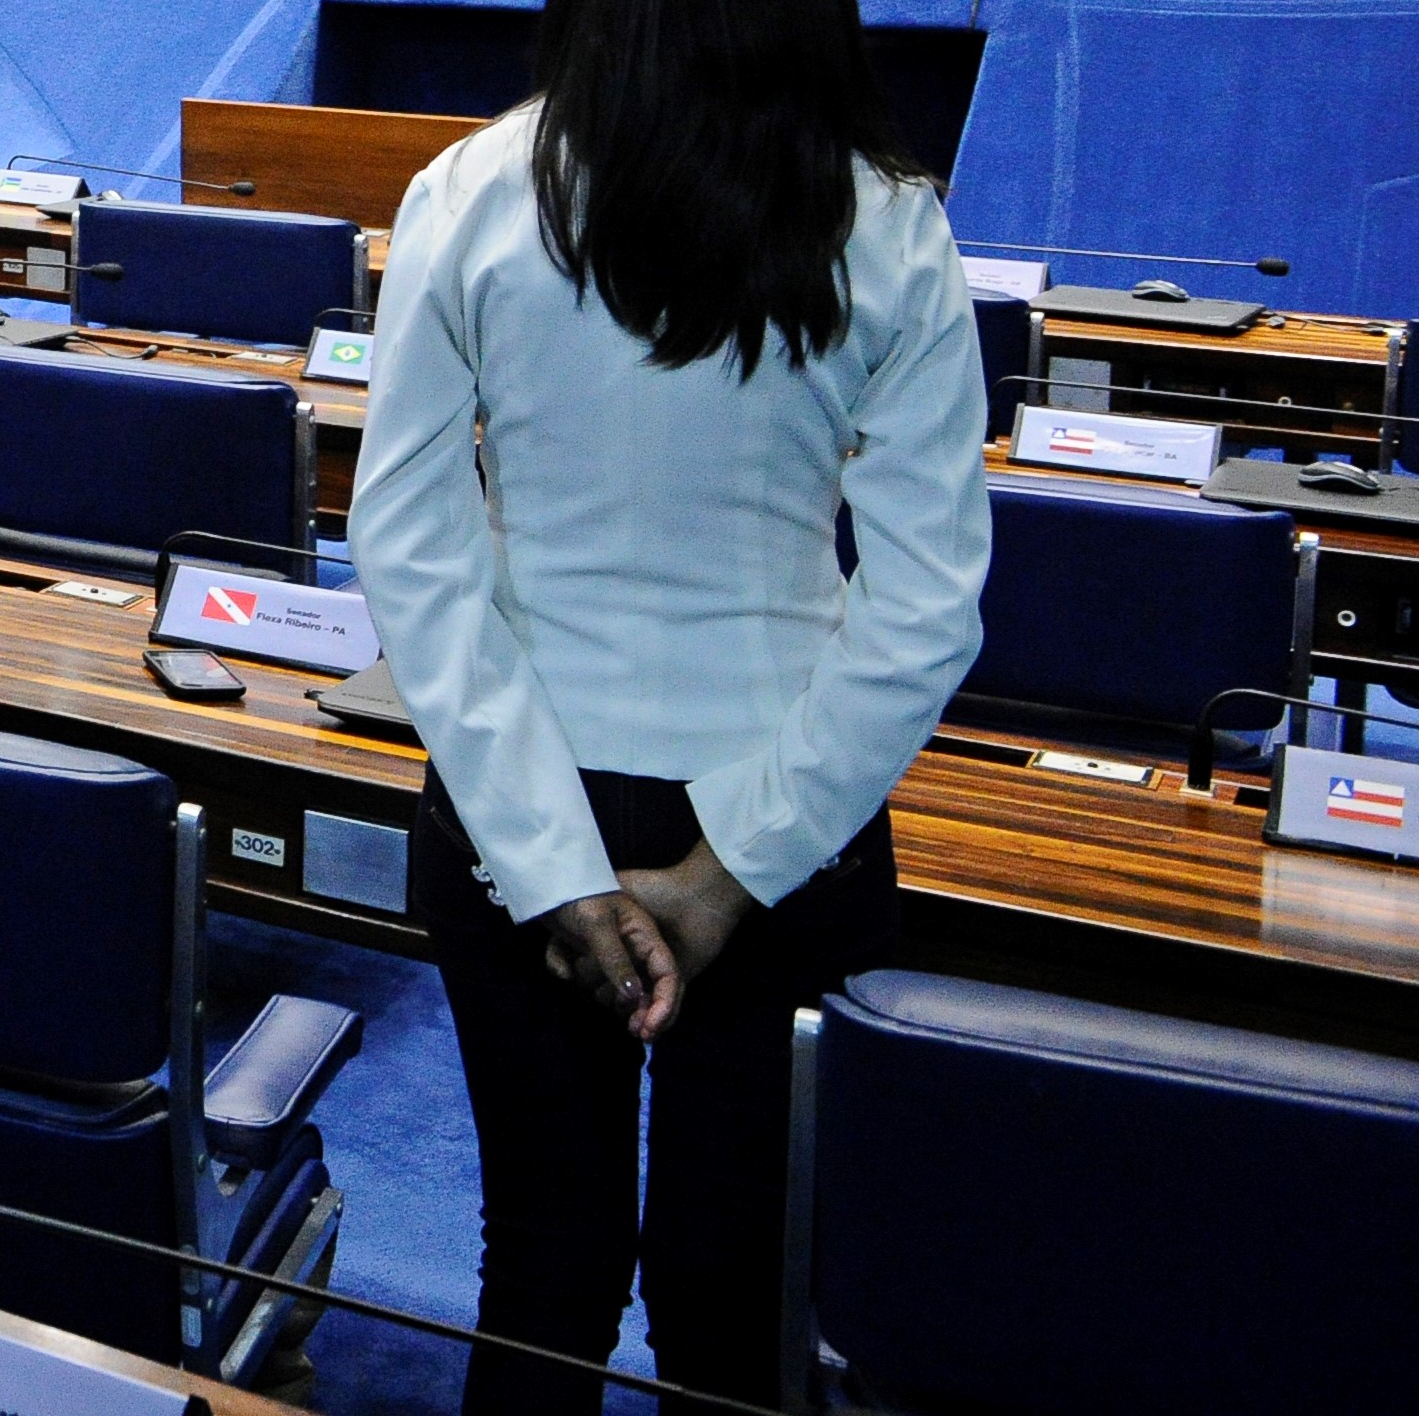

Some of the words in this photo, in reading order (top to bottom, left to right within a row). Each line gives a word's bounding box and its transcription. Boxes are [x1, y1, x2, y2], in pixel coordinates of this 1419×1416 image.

[256, 612, 282, 624] Flexa
[285, 617, 321, 631] Ribeiro
[331, 626, 346, 635] PA
[286, 607, 321, 619] Senador
[240, 835, 275, 856] 302
